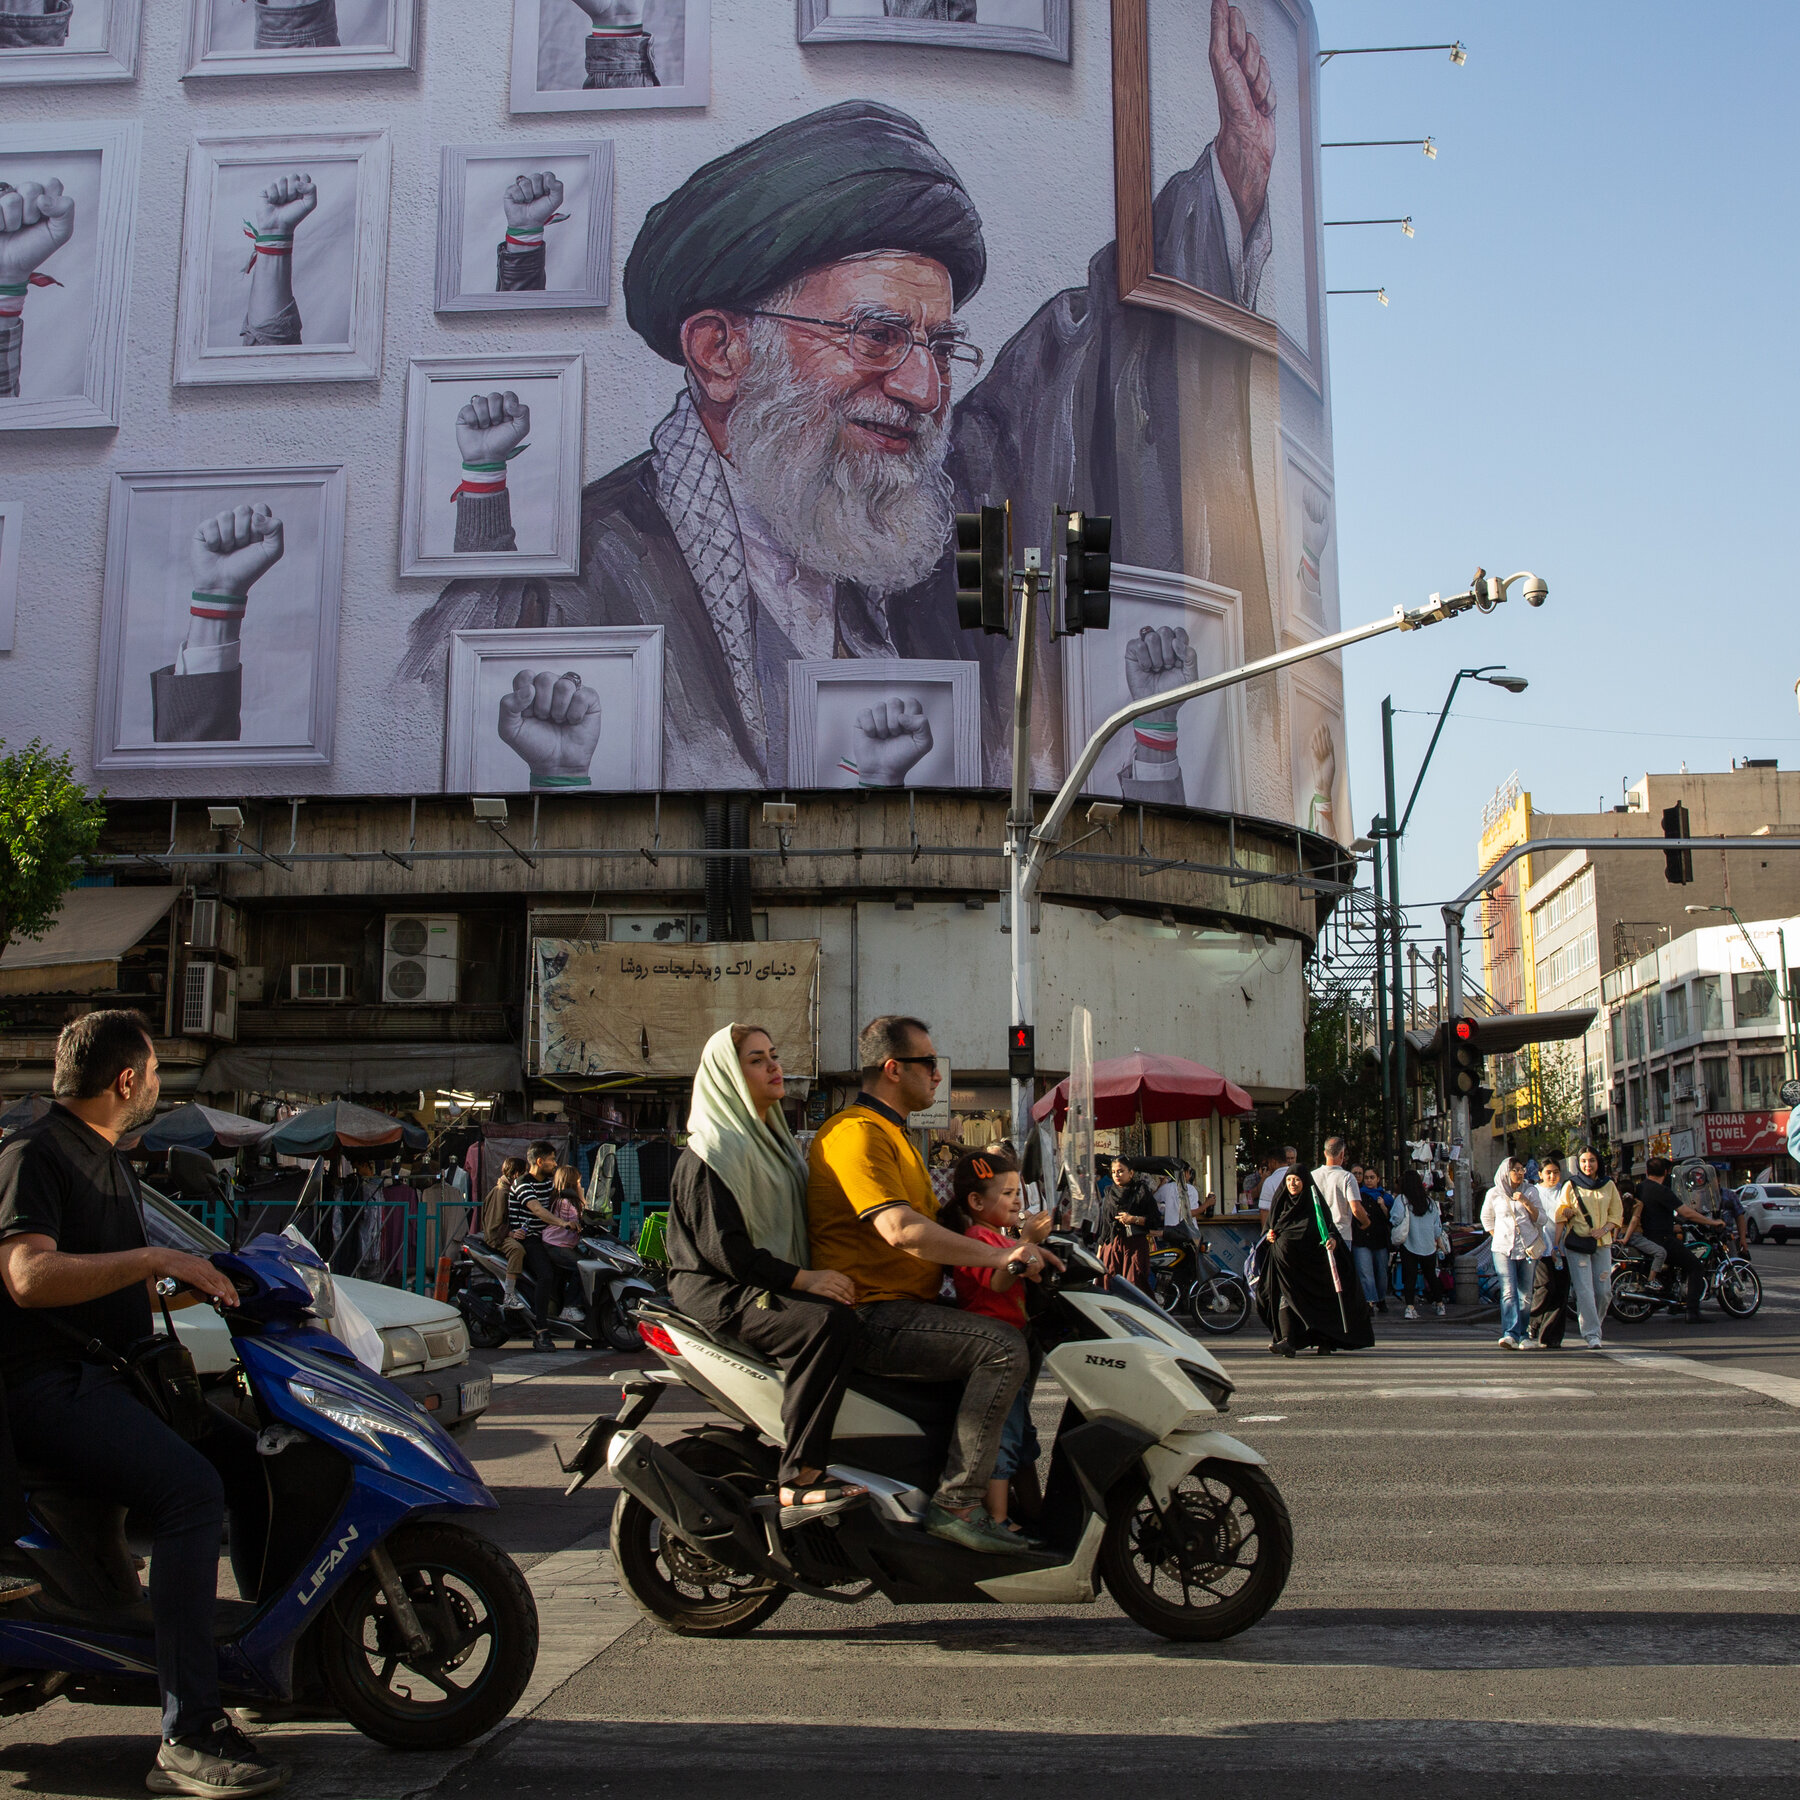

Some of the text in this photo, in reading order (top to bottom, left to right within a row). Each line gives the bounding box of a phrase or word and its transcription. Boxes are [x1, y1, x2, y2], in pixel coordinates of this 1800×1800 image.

[620, 957, 649, 980] روشا
[725, 959, 752, 976] لاک
[755, 960, 796, 981] دنیای
[1707, 1113, 1746, 1126] HONAR
[1708, 1127, 1747, 1140] TOWEL
[1085, 1354, 1127, 1369] NMS
[297, 1523, 359, 1606] LIFAN
